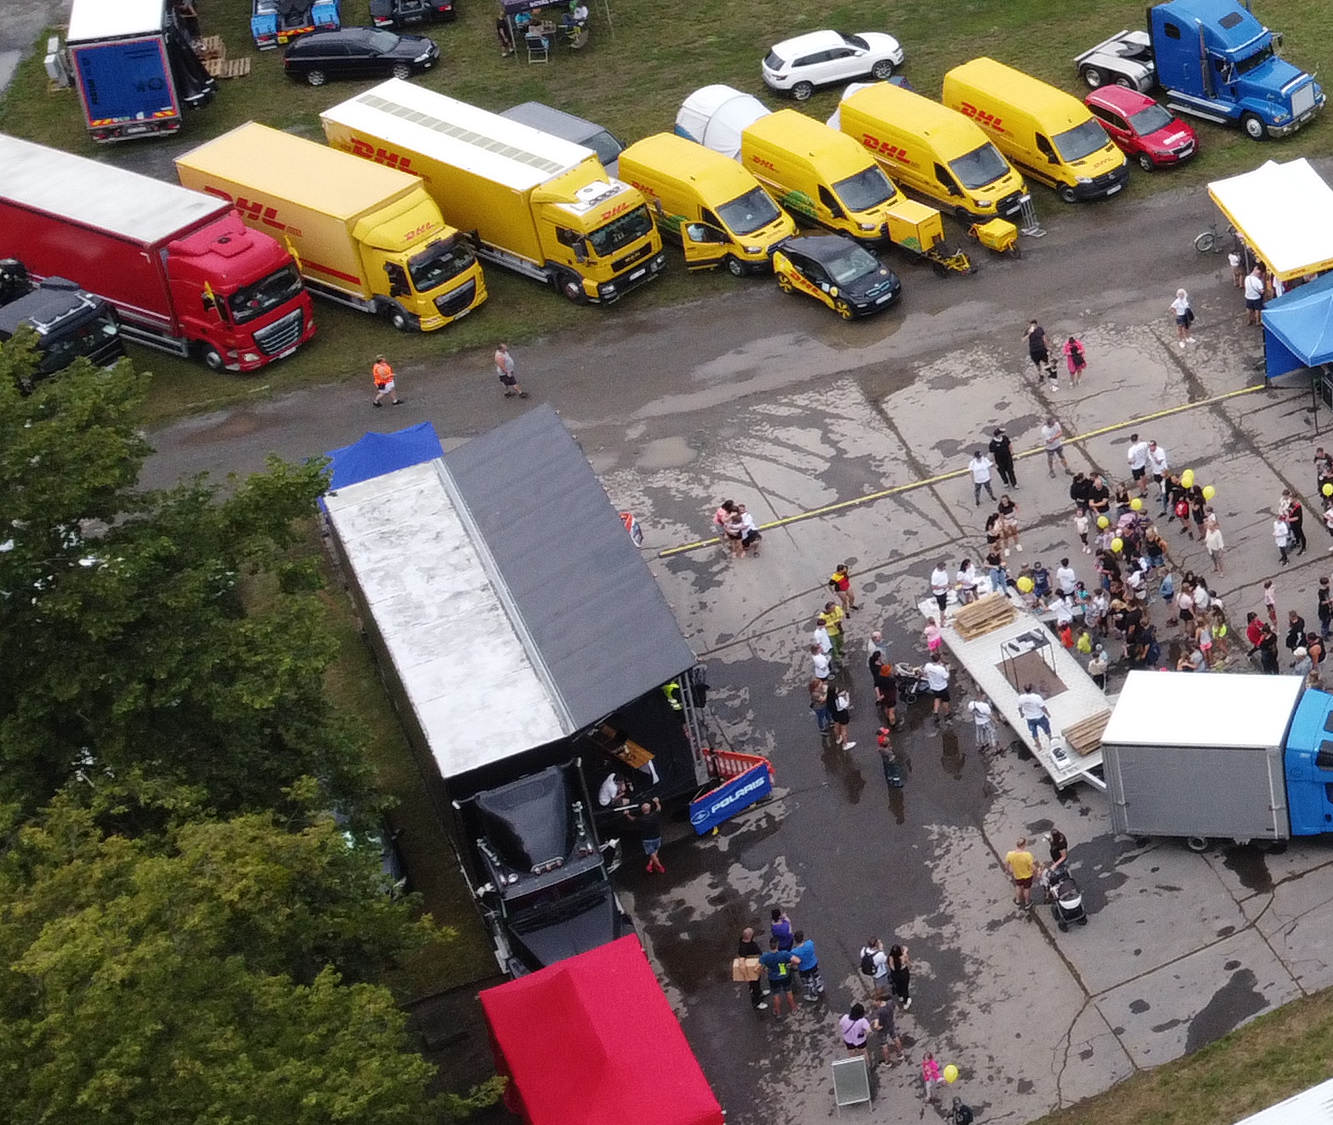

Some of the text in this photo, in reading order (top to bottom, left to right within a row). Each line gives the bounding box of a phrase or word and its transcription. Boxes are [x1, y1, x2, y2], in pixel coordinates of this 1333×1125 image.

[961, 102, 1006, 133] DHL
[351, 138, 420, 176] DHL
[863, 133, 911, 164] DHL
[601, 202, 630, 221] DHL
[405, 222, 434, 241] DHL
[711, 777, 765, 814] POLARIS
